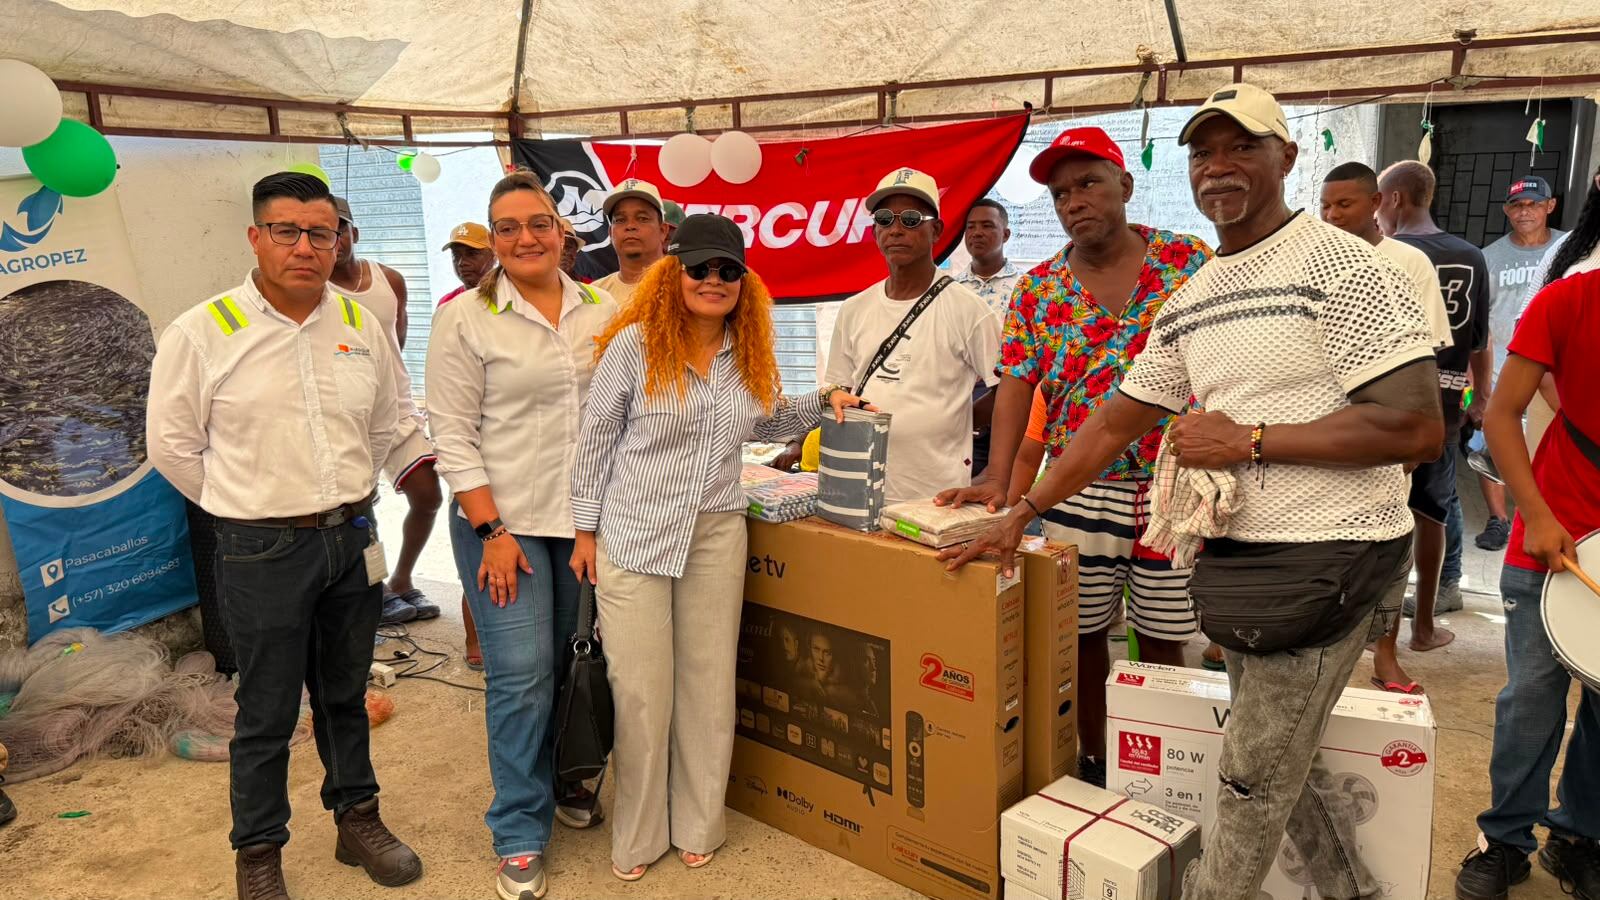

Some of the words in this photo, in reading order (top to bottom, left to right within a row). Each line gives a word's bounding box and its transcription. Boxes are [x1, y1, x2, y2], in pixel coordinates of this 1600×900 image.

[918, 294, 933, 309] NIKE
[902, 313, 916, 330] NIKE
[886, 334, 900, 351] NIKE
[65, 536, 149, 568] Pasacaballos
[72, 587, 104, 608] (+57)
[106, 578, 130, 594] 320
[1167, 748, 1185, 761] 80
[1190, 752, 1205, 763] W
[1397, 751, 1411, 766] 2
[1166, 765, 1194, 774] potencia
[788, 791, 814, 813] Dolby
[1165, 787, 1173, 798] 3
[1176, 791, 1193, 801] en
[1197, 792, 1203, 802] 1
[823, 808, 861, 833] HDMI
